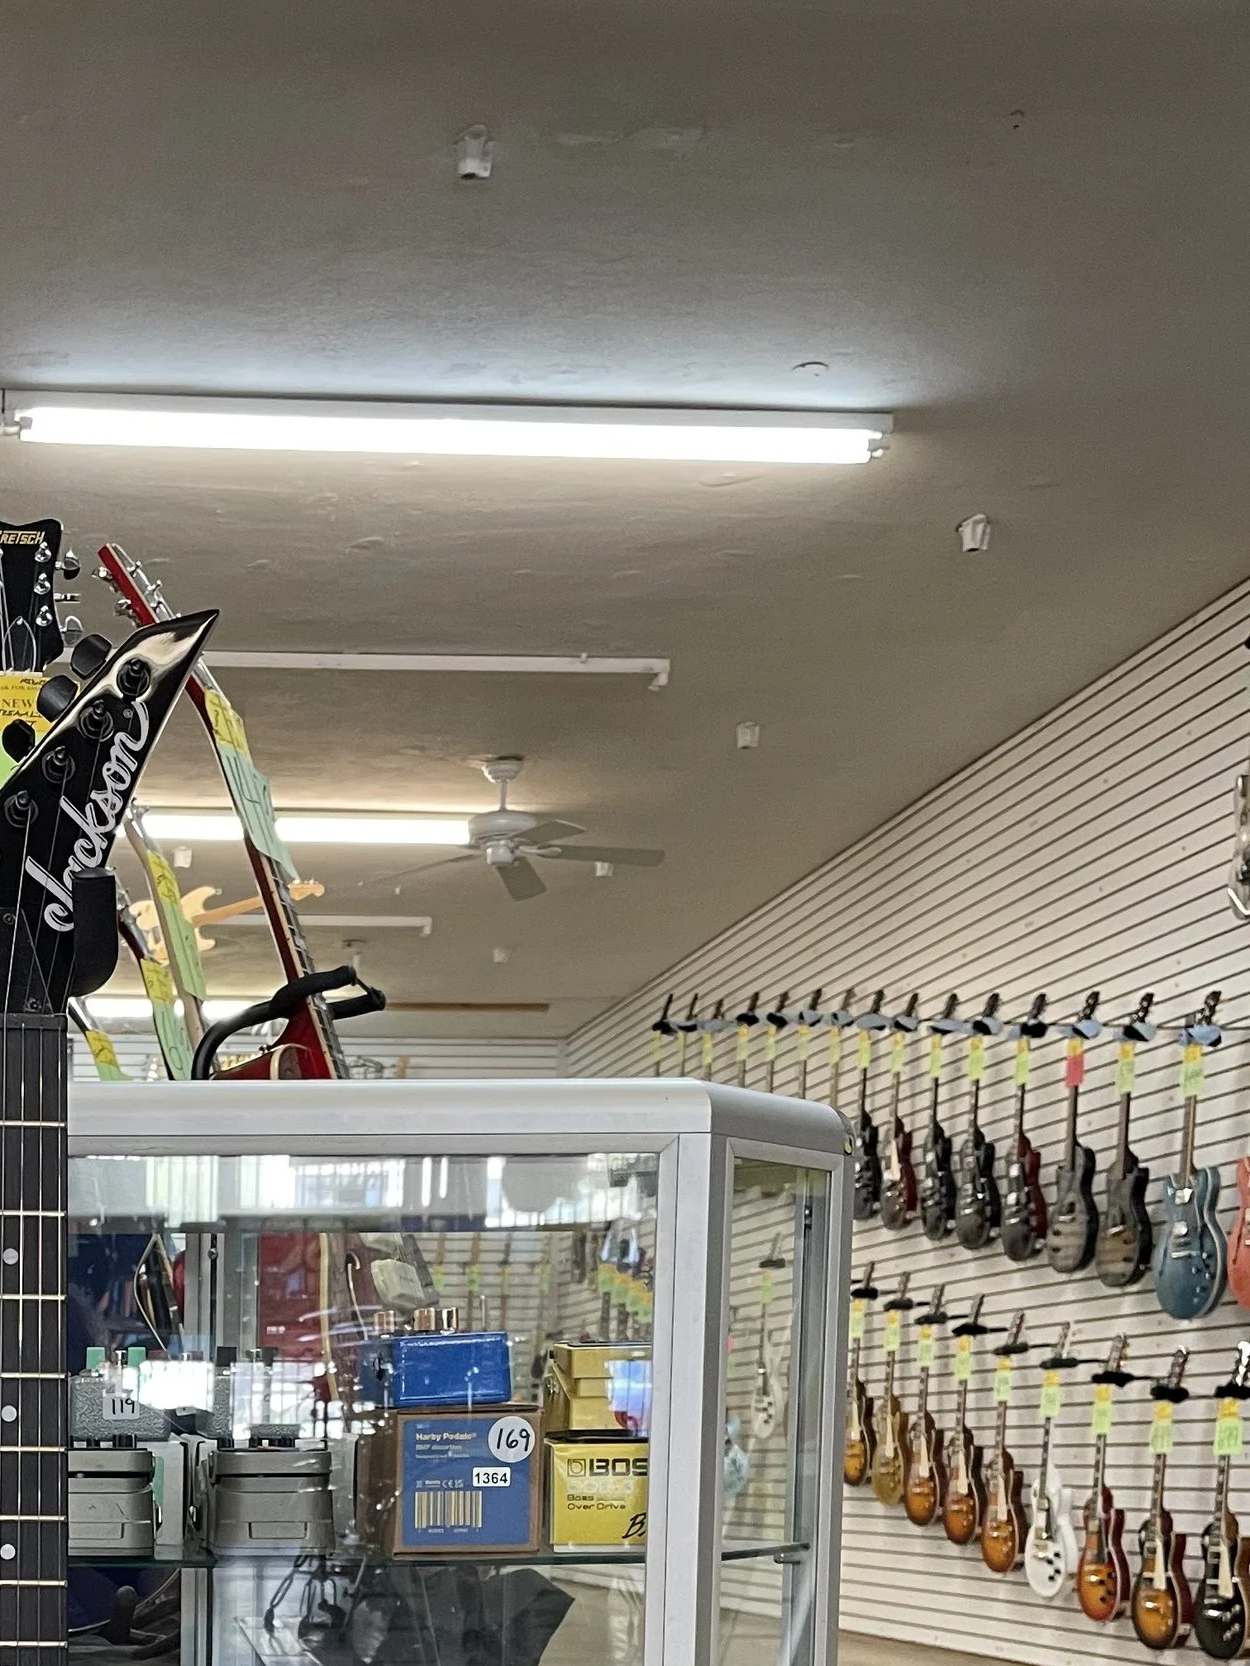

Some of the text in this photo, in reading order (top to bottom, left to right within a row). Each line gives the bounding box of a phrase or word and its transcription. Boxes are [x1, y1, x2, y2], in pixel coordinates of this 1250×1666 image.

[2, 698, 32, 708] NEW
[25, 700, 150, 932] Jackson
[111, 1398, 135, 1416] 119
[496, 1428, 530, 1452] 169
[474, 1472, 508, 1485] 1364
[567, 1493, 595, 1502] Bass
[567, 1502, 626, 1511] Over Drive
